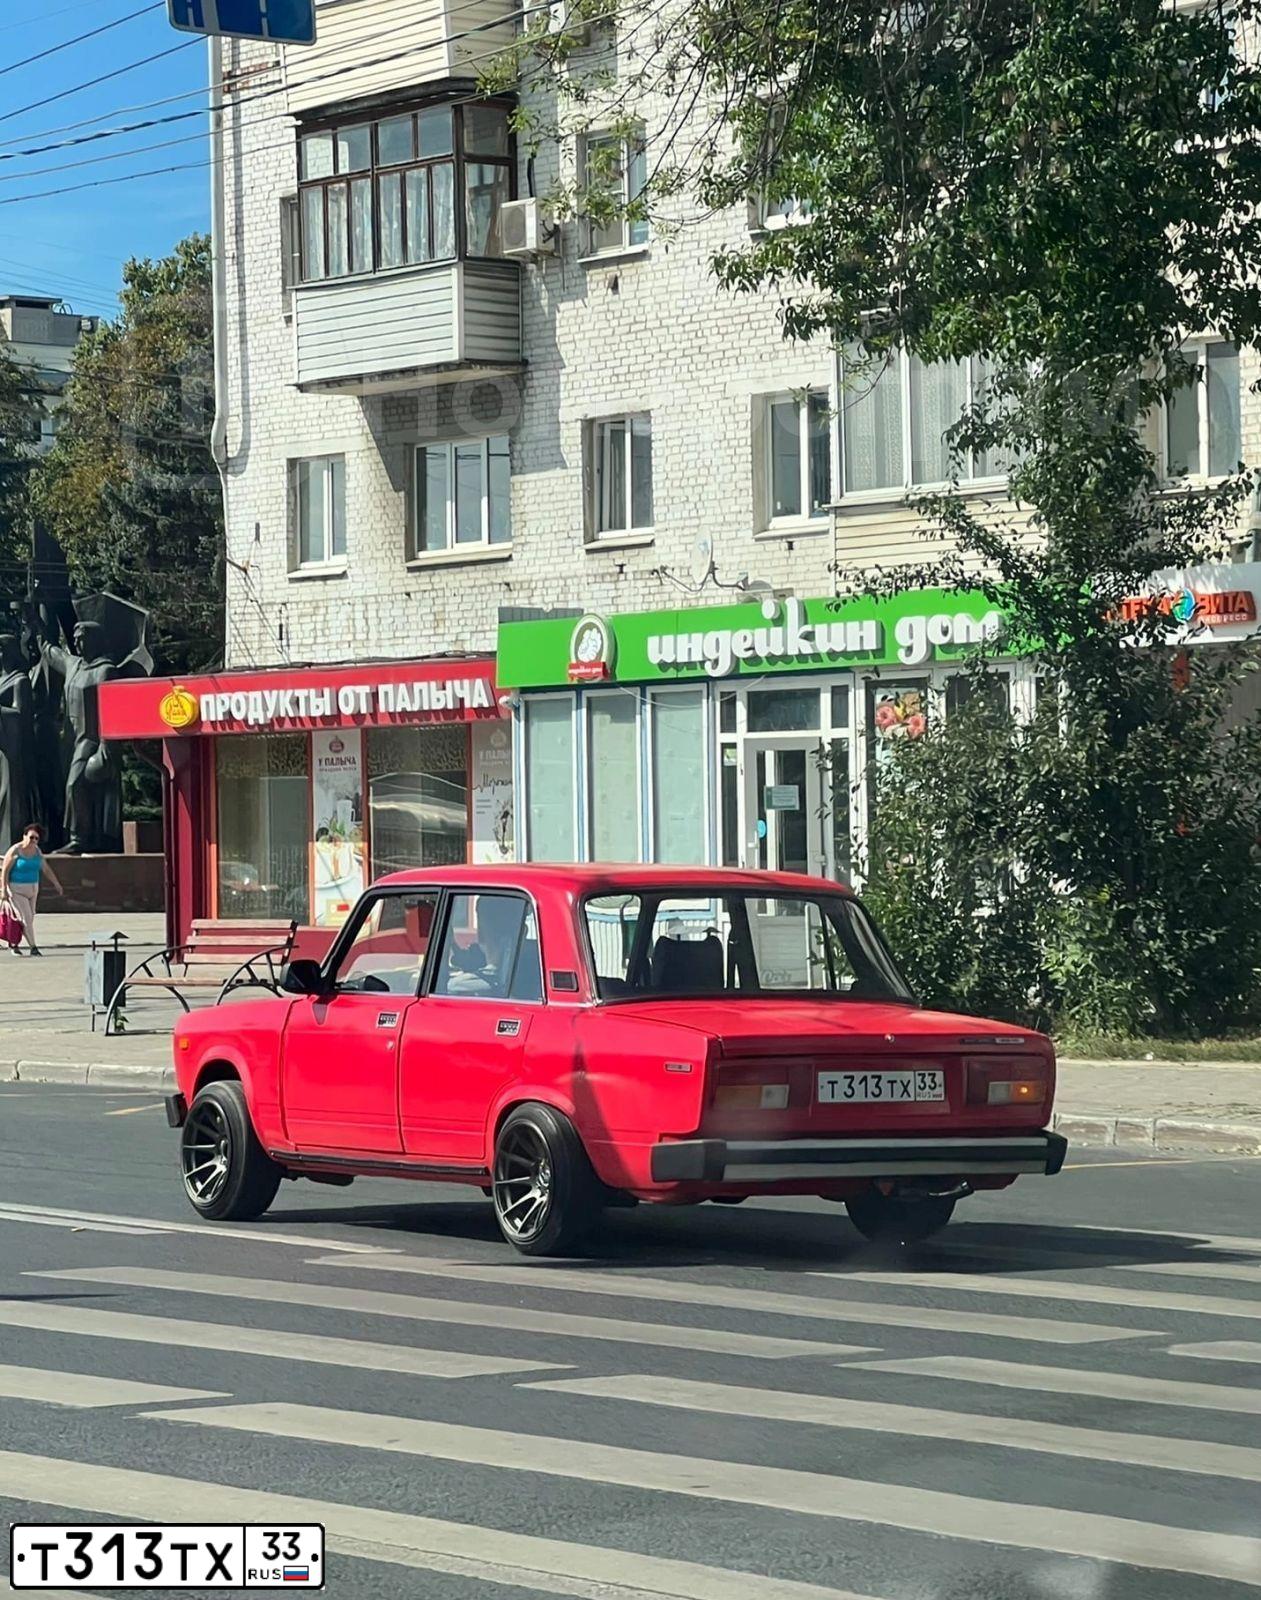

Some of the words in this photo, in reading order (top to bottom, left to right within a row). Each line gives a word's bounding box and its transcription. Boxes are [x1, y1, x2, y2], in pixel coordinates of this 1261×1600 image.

[1196, 592, 1249, 614] ВИТА
[647, 598, 881, 677] индейкин
[895, 611, 1002, 664] дом
[201, 690, 331, 722] ПРОДУКТЫ
[338, 685, 372, 715] ОТ
[378, 679, 489, 712] ПАЛЫЧА
[325, 755, 356, 766] ПАЛЫЧА
[827, 1075, 912, 1098] Т313ТХ
[917, 1073, 937, 1091] 33
